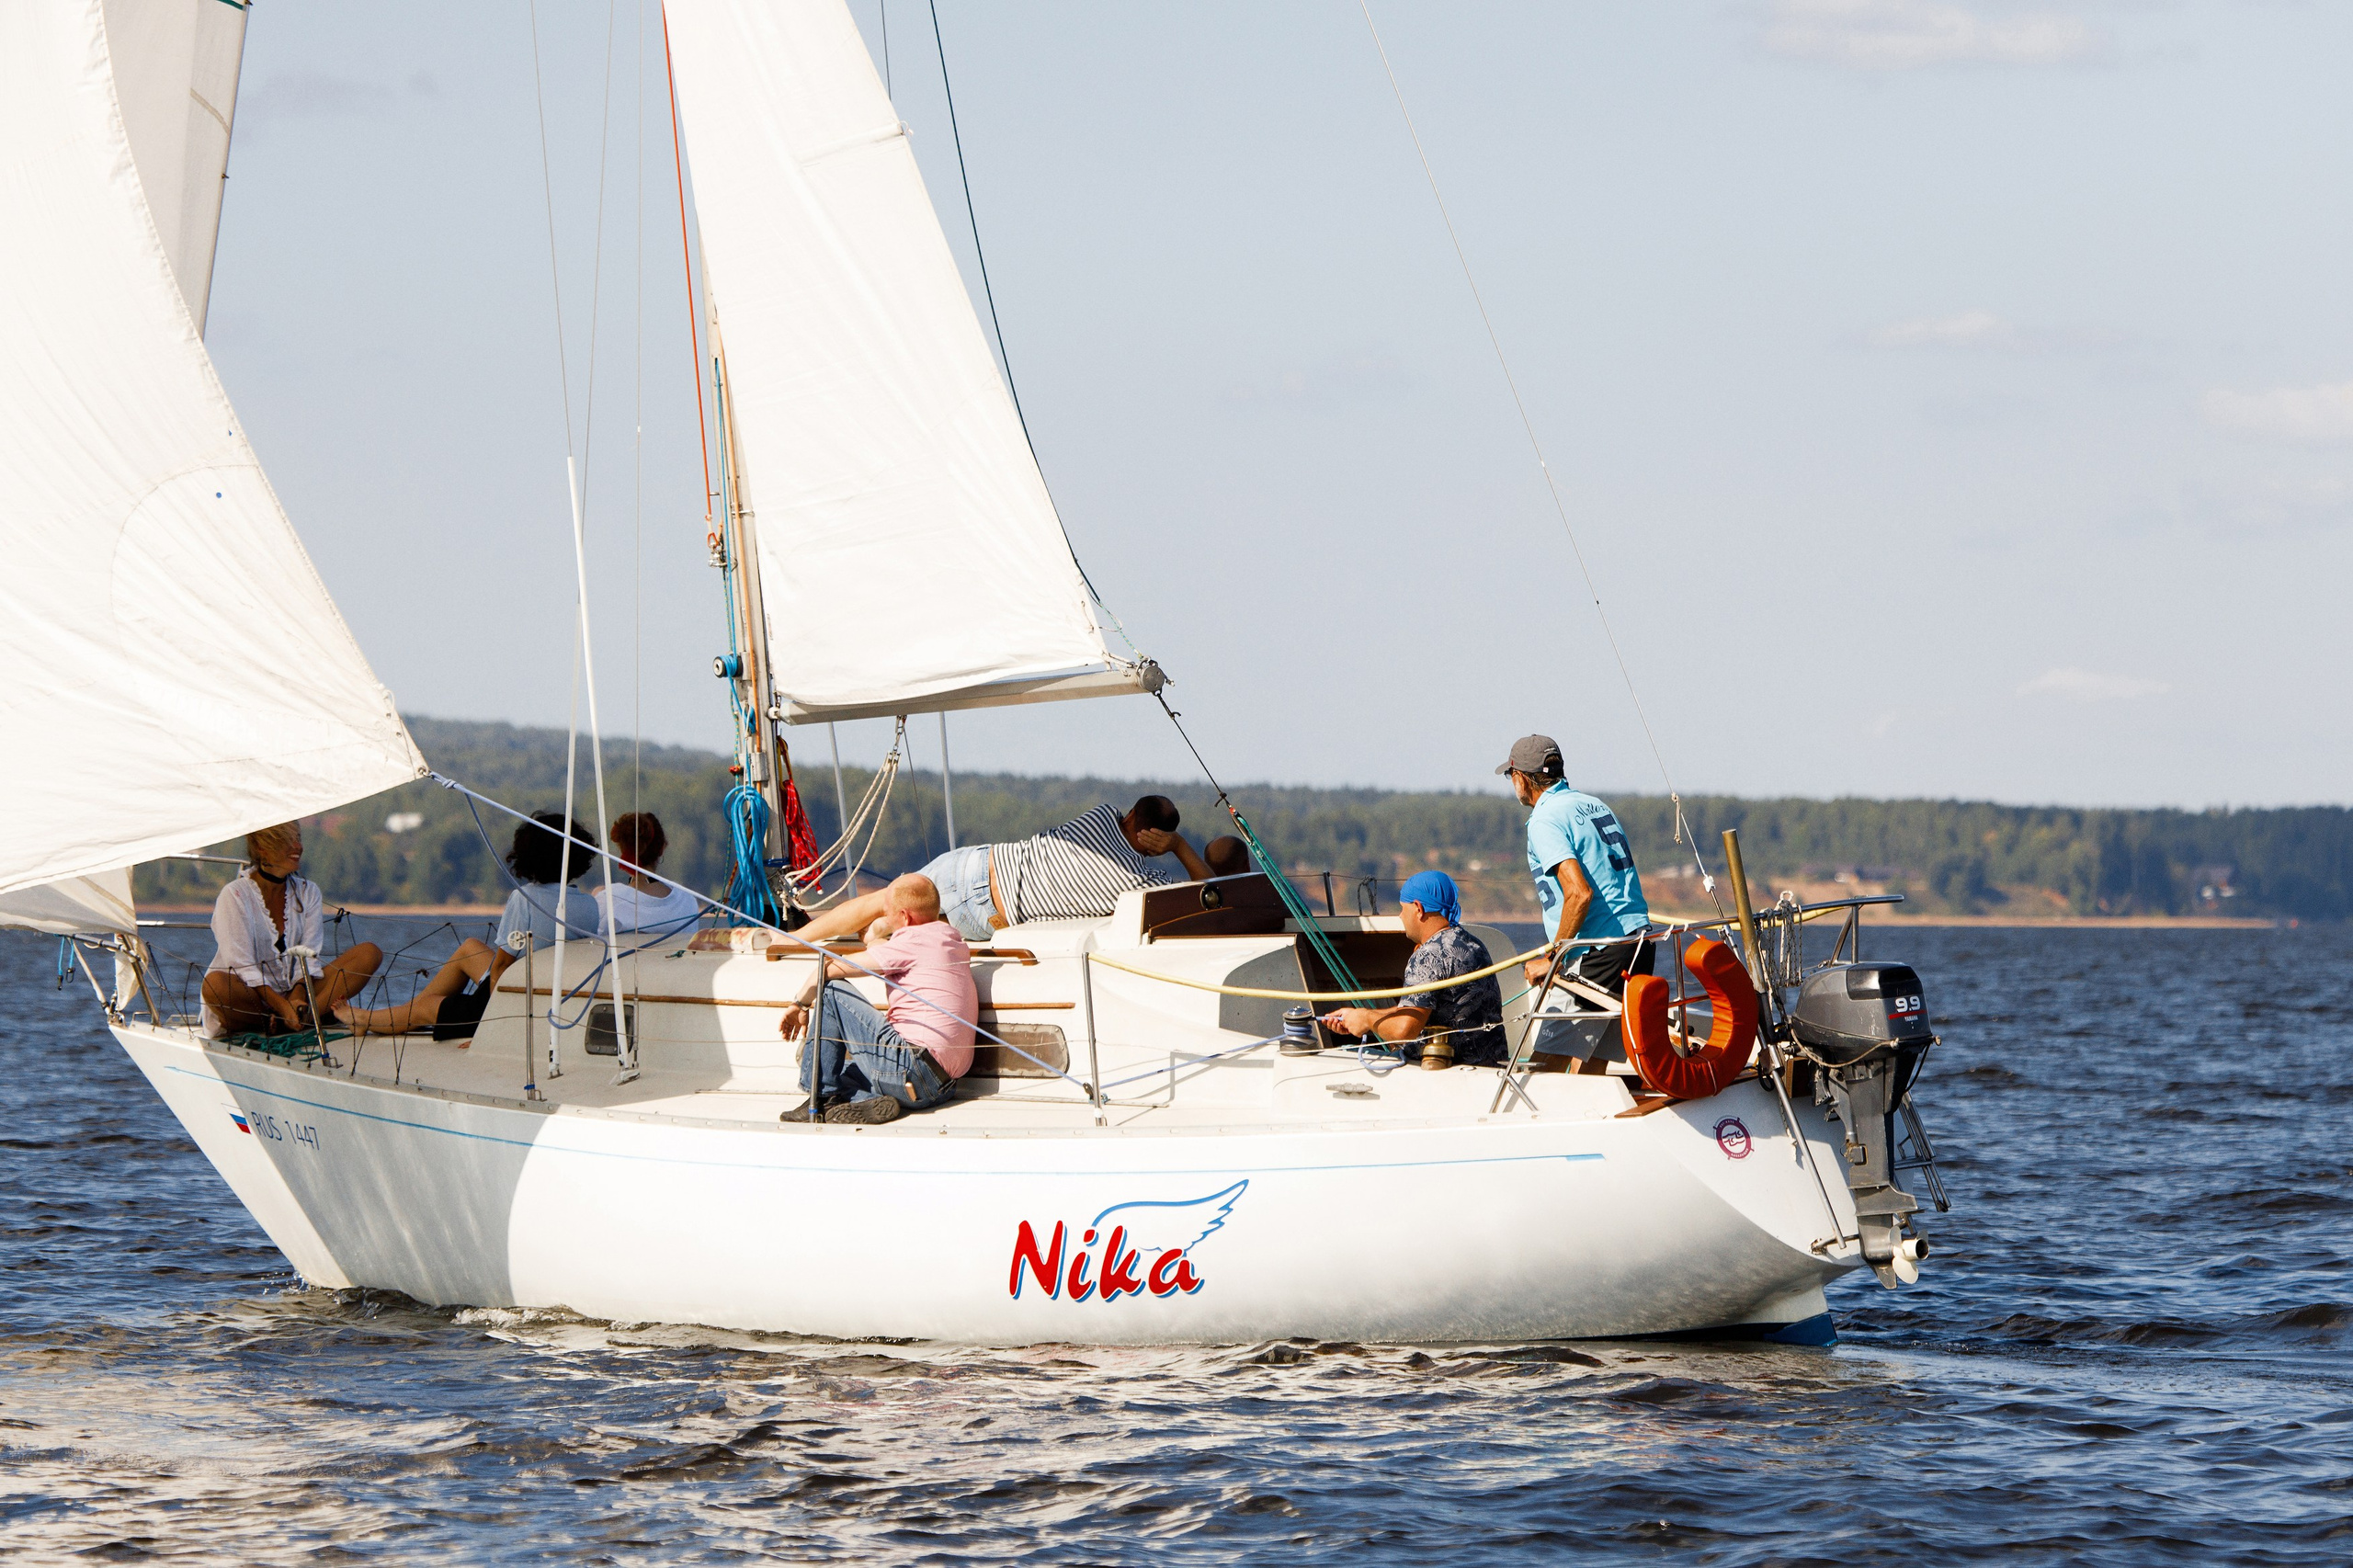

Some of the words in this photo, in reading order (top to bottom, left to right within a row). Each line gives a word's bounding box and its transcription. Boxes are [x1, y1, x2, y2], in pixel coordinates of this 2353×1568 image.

[1591, 813, 1634, 872] 5
[1894, 995, 1921, 1013] 9.9
[251, 1110, 282, 1142] RUS
[285, 1120, 320, 1151] 1447
[1009, 1220, 1205, 1304] Nika
